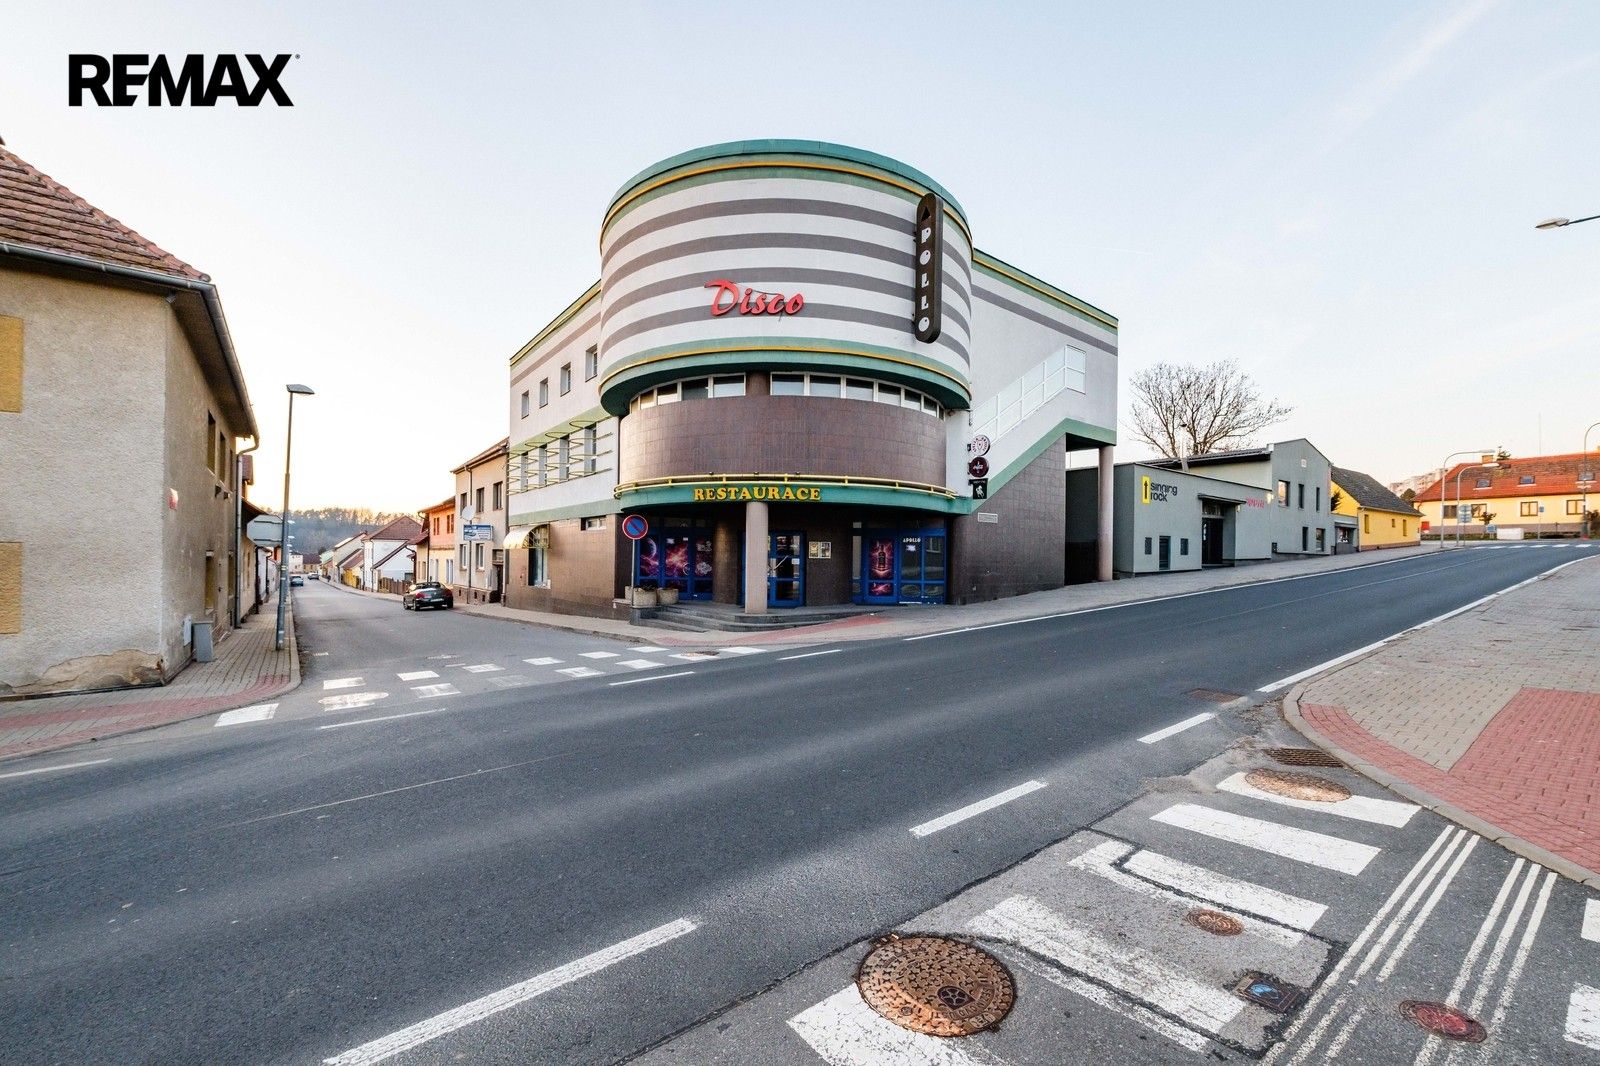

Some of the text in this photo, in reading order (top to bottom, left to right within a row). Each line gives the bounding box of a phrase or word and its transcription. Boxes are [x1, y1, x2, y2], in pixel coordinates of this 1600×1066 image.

[704, 279, 805, 316] Disco
[693, 486, 821, 501] RESTAURACE
[1150, 482, 1178, 496] singing
[1150, 492, 1168, 502] rock
